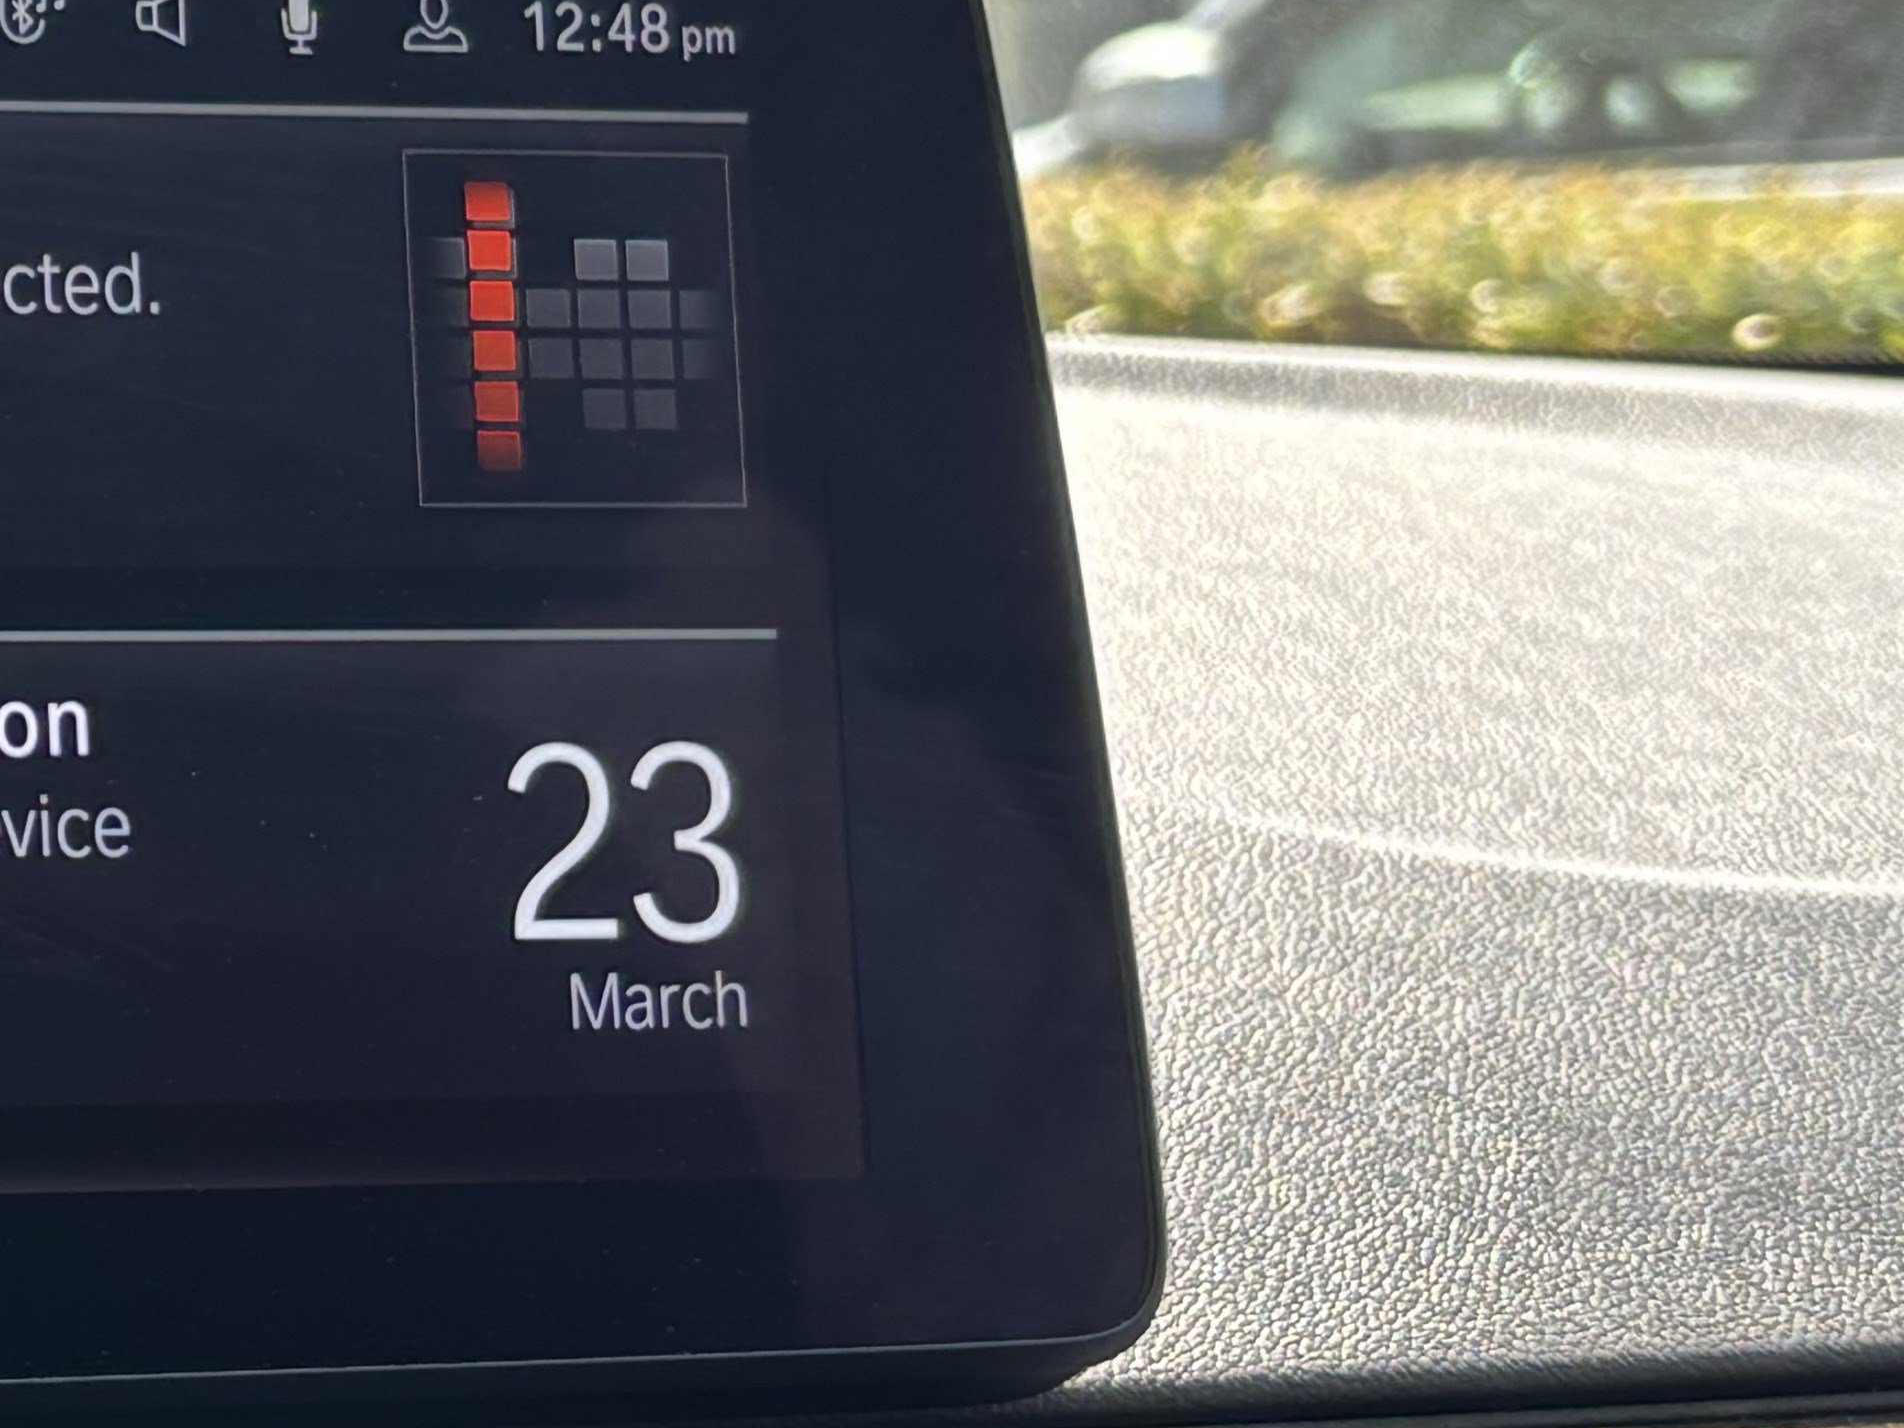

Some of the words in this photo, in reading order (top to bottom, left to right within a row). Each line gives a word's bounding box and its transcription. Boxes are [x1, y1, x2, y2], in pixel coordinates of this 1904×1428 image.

[522, 0, 671, 54] 12:48
[680, 24, 737, 63] pm
[506, 740, 741, 945] 23
[569, 969, 749, 1032] March
